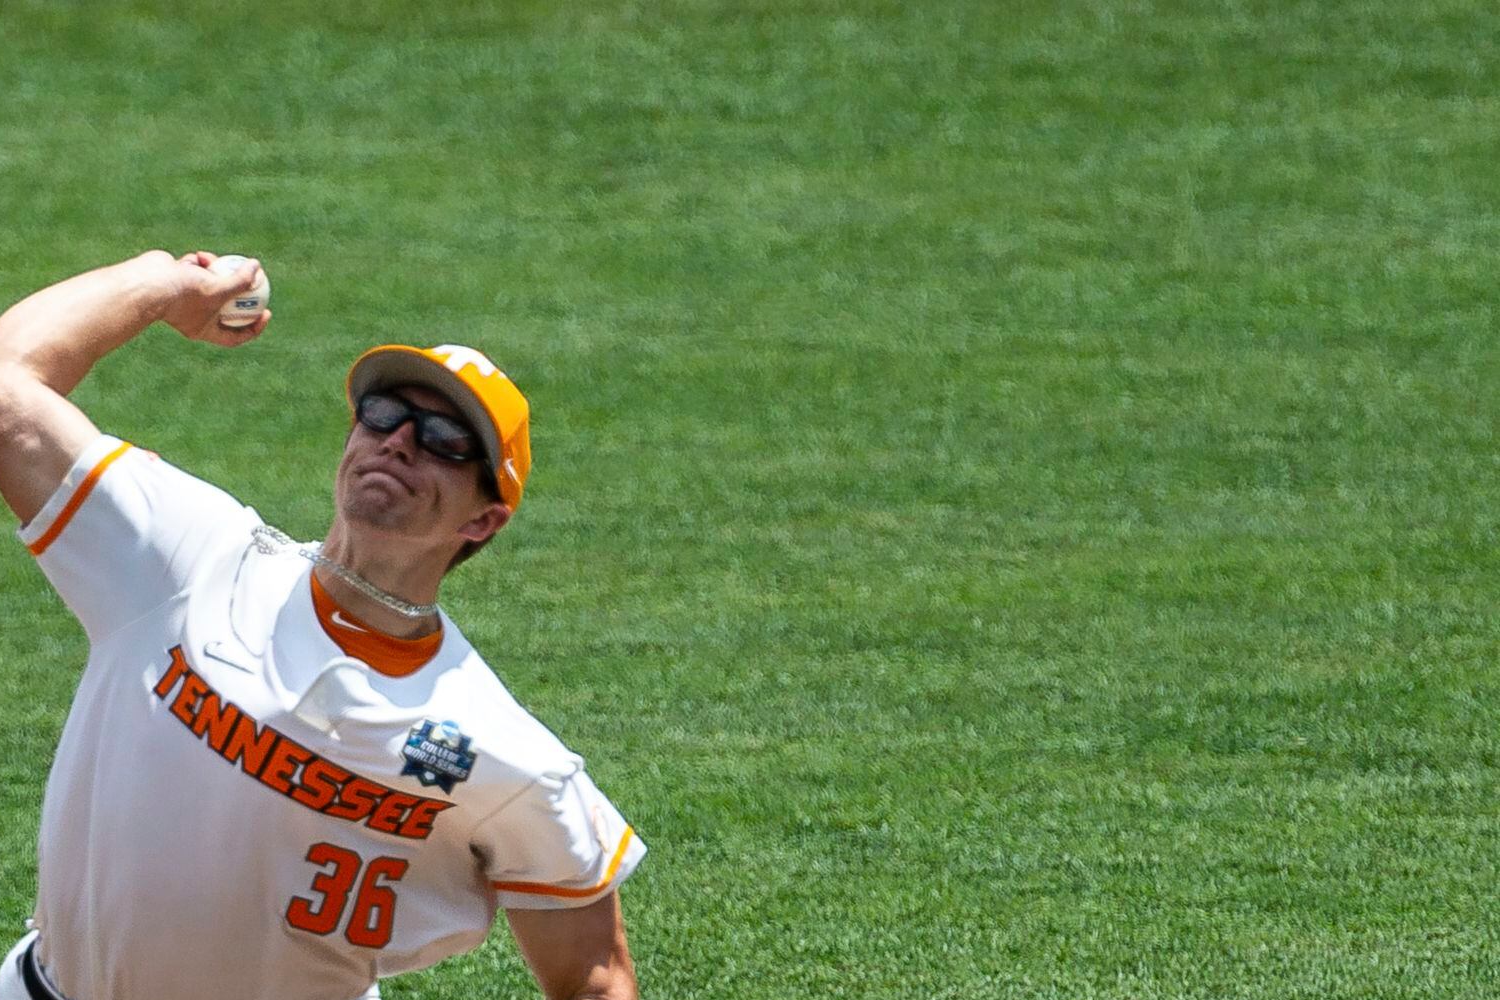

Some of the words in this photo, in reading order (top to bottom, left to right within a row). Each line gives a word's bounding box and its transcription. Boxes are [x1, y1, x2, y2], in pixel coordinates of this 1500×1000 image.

[153, 644, 457, 839] TENNESSEE
[403, 744, 437, 765] WORLD
[285, 841, 410, 949] 36
